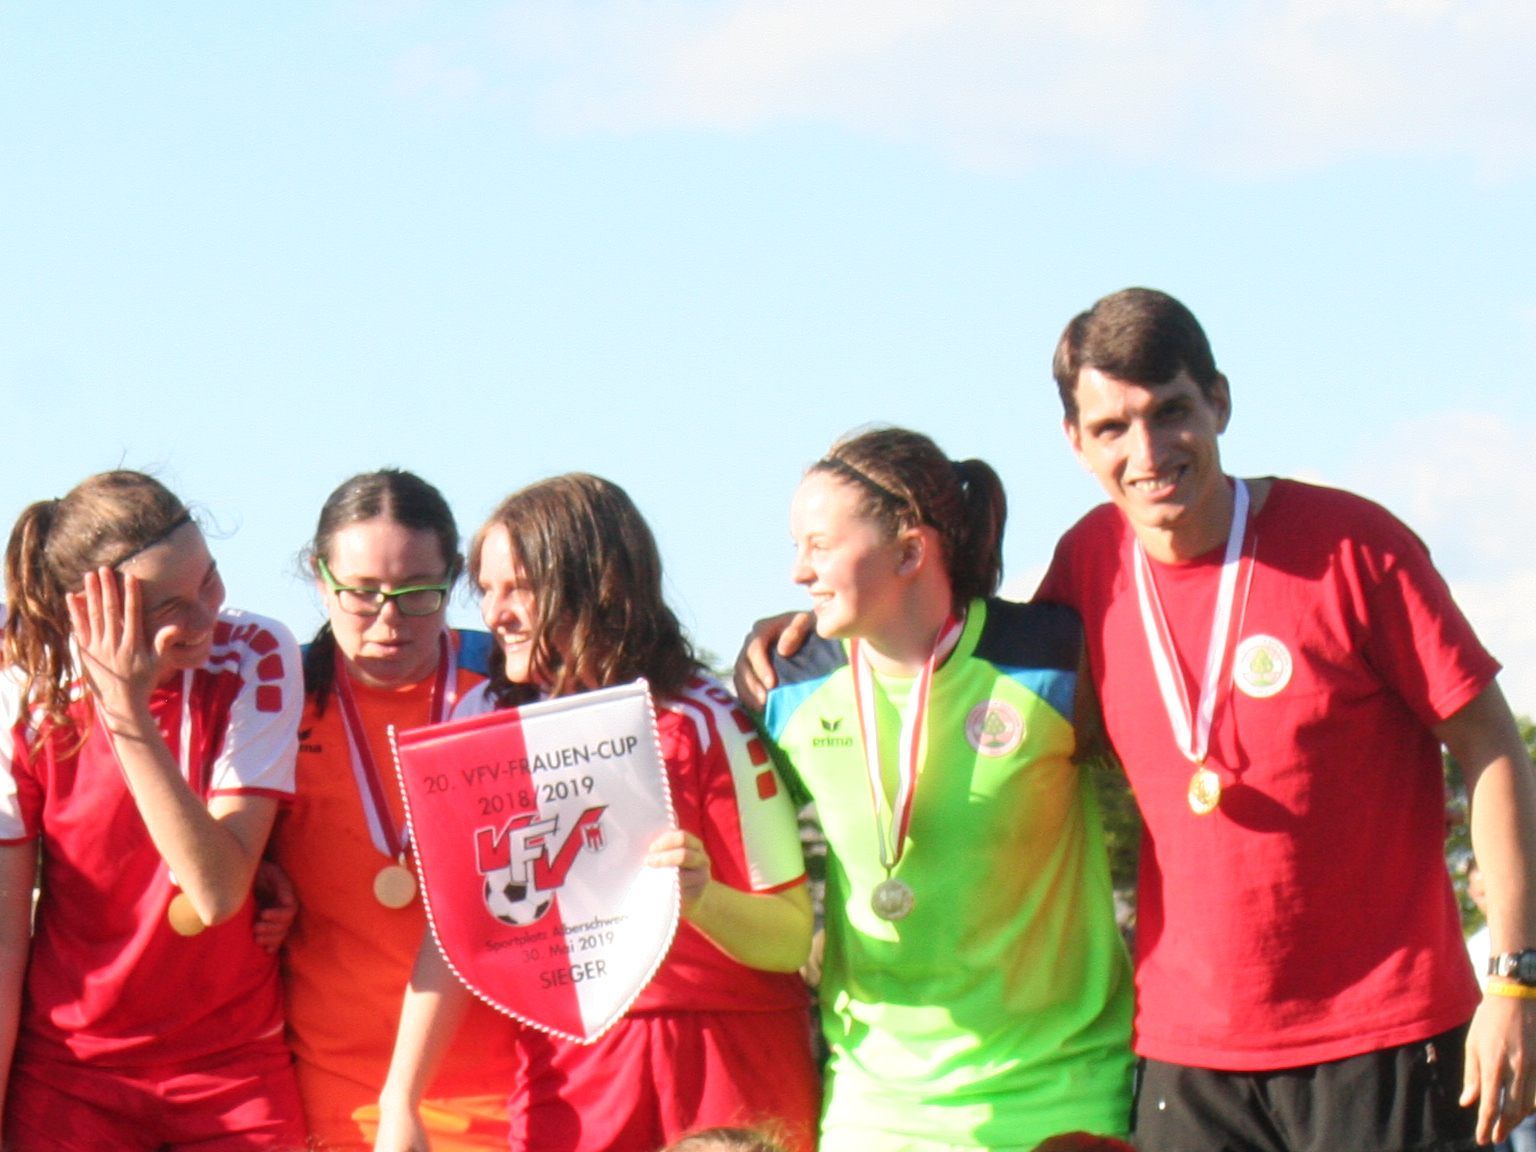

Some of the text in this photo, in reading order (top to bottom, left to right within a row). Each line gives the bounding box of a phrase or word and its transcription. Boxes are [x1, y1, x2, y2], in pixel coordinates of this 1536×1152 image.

[812, 735, 853, 748] erima
[423, 736, 638, 795] 20. VFV-FRAUEN-CUP
[474, 805, 609, 892] VFV
[578, 931, 615, 951] 2019
[540, 960, 608, 989] SIEGER
